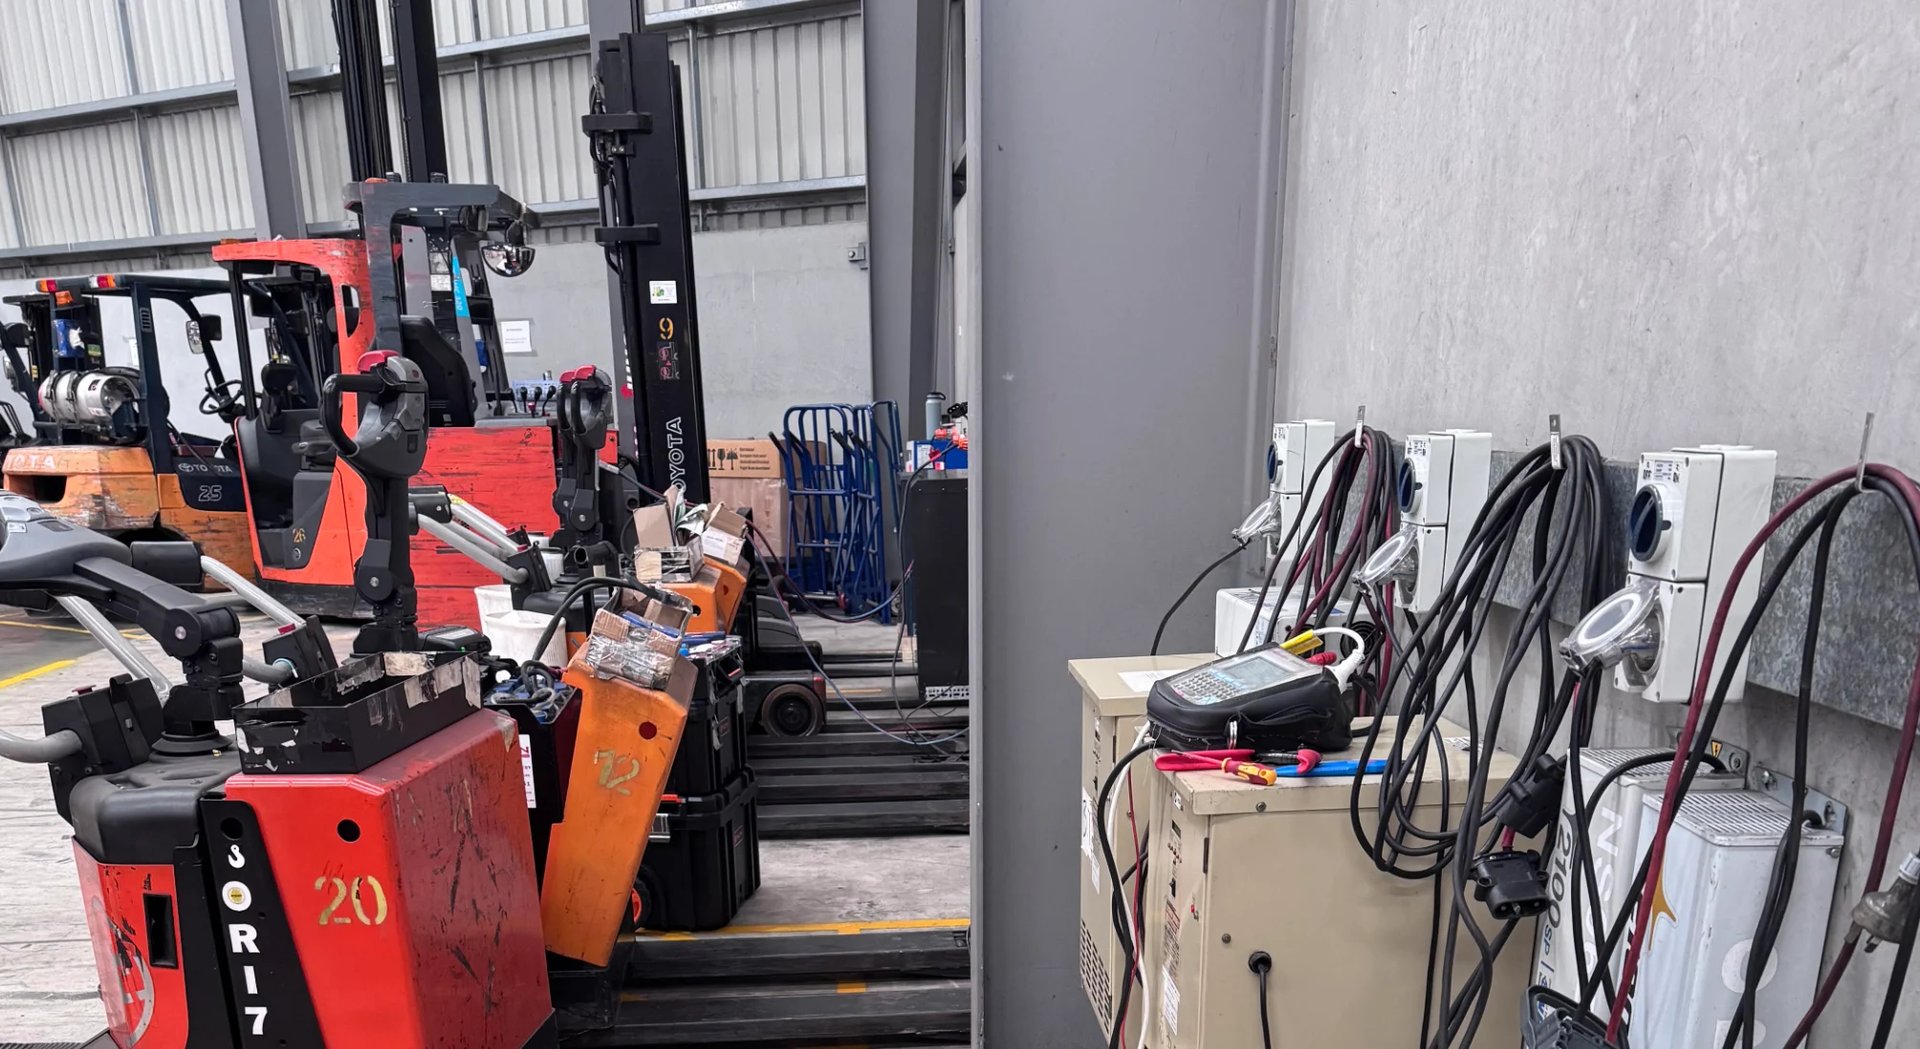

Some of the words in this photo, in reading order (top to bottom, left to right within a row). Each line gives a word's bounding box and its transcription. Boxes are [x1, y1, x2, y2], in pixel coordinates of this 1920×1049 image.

[658, 317, 674, 340] 9
[198, 484, 223, 502] 25
[1548, 823, 1572, 929] 2100
[314, 875, 388, 926] 20
[1543, 924, 1553, 956] SP
